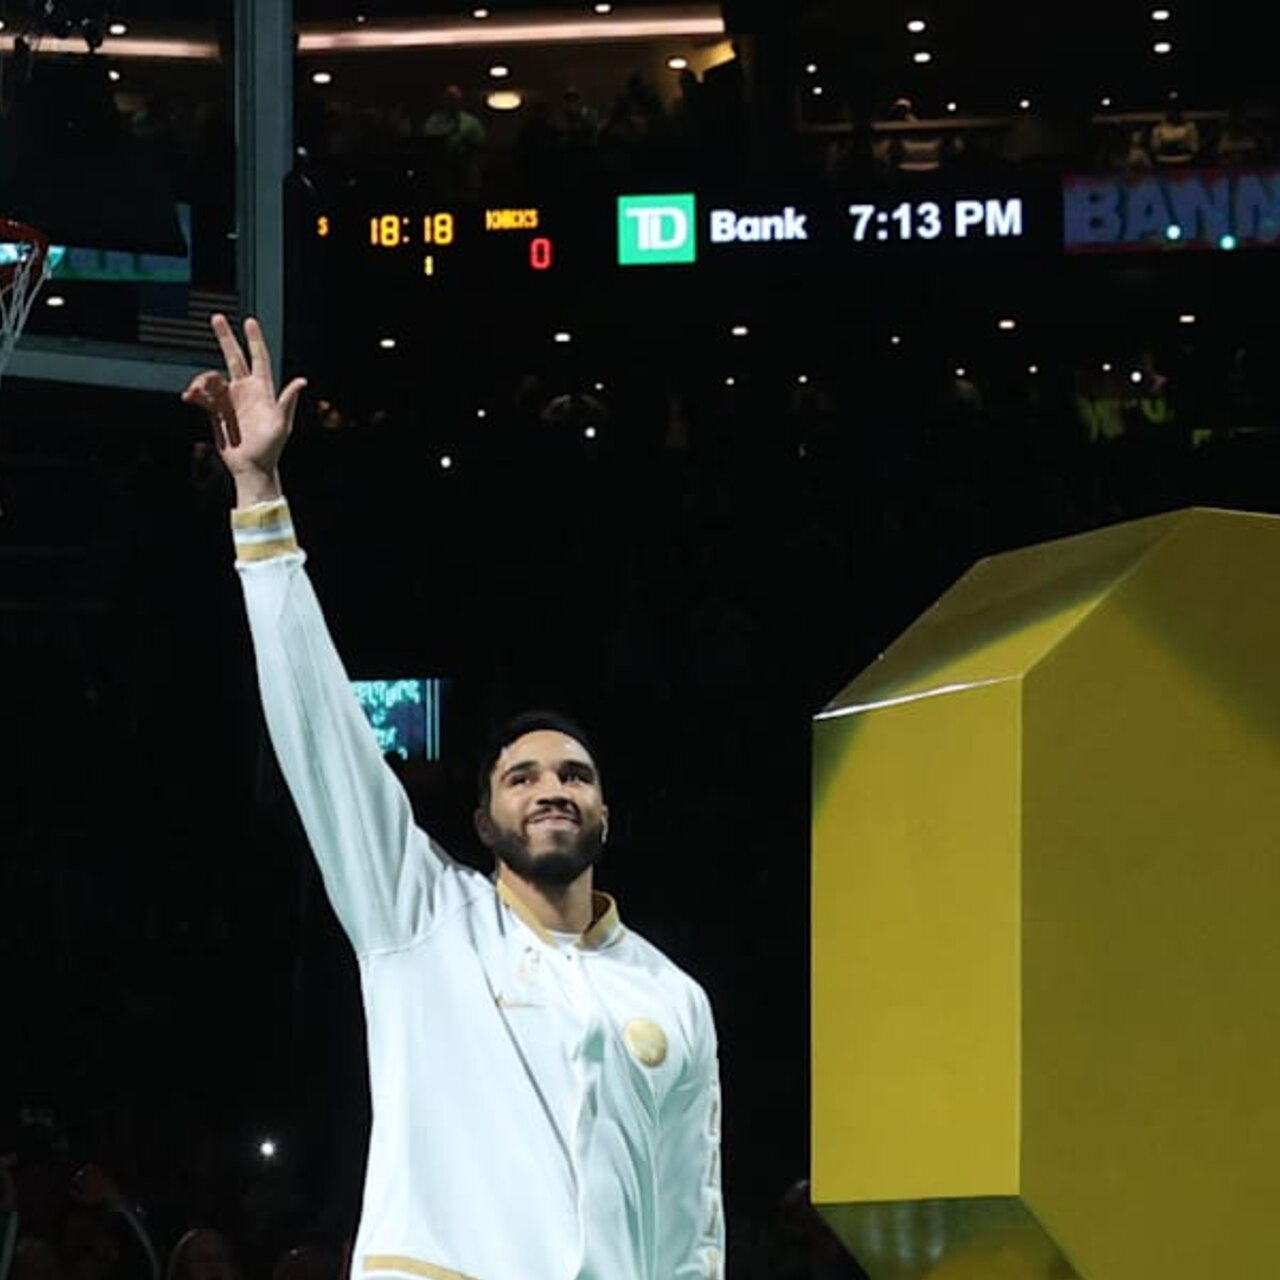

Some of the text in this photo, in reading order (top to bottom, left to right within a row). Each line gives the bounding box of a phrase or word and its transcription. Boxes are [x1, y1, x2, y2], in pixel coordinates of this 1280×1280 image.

[626, 206, 808, 251] TD Bank
[848, 199, 1023, 241] 7:13 PM
